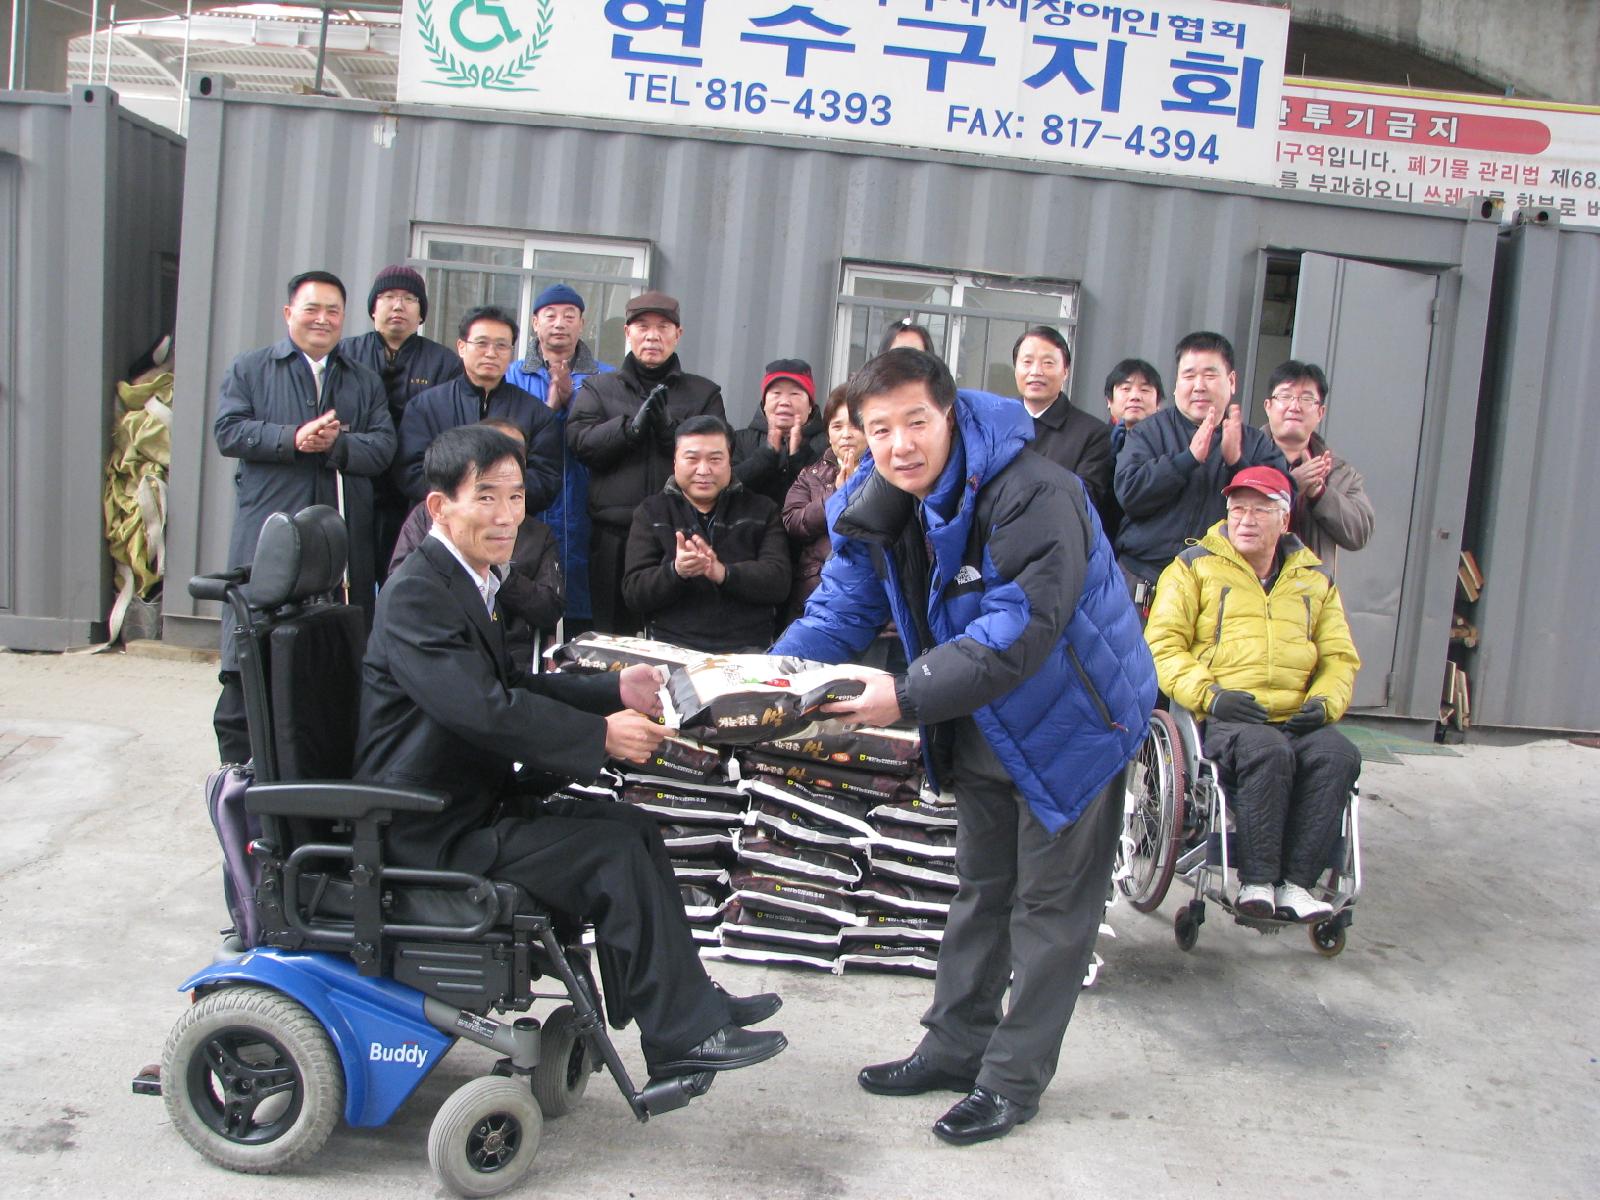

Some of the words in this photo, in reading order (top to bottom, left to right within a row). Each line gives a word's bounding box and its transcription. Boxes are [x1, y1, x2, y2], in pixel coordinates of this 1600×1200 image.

[704, 78, 892, 127] 816-4393
[947, 104, 1025, 140] FAX:
[1040, 114, 1220, 165] 817-4394
[1308, 173, 1414, 203] 부과하오니
[1407, 155, 1470, 180] 폐기물
[1478, 161, 1541, 186] 관리법
[1549, 168, 1600, 190] 제68
[369, 1042, 429, 1068] Buddy
